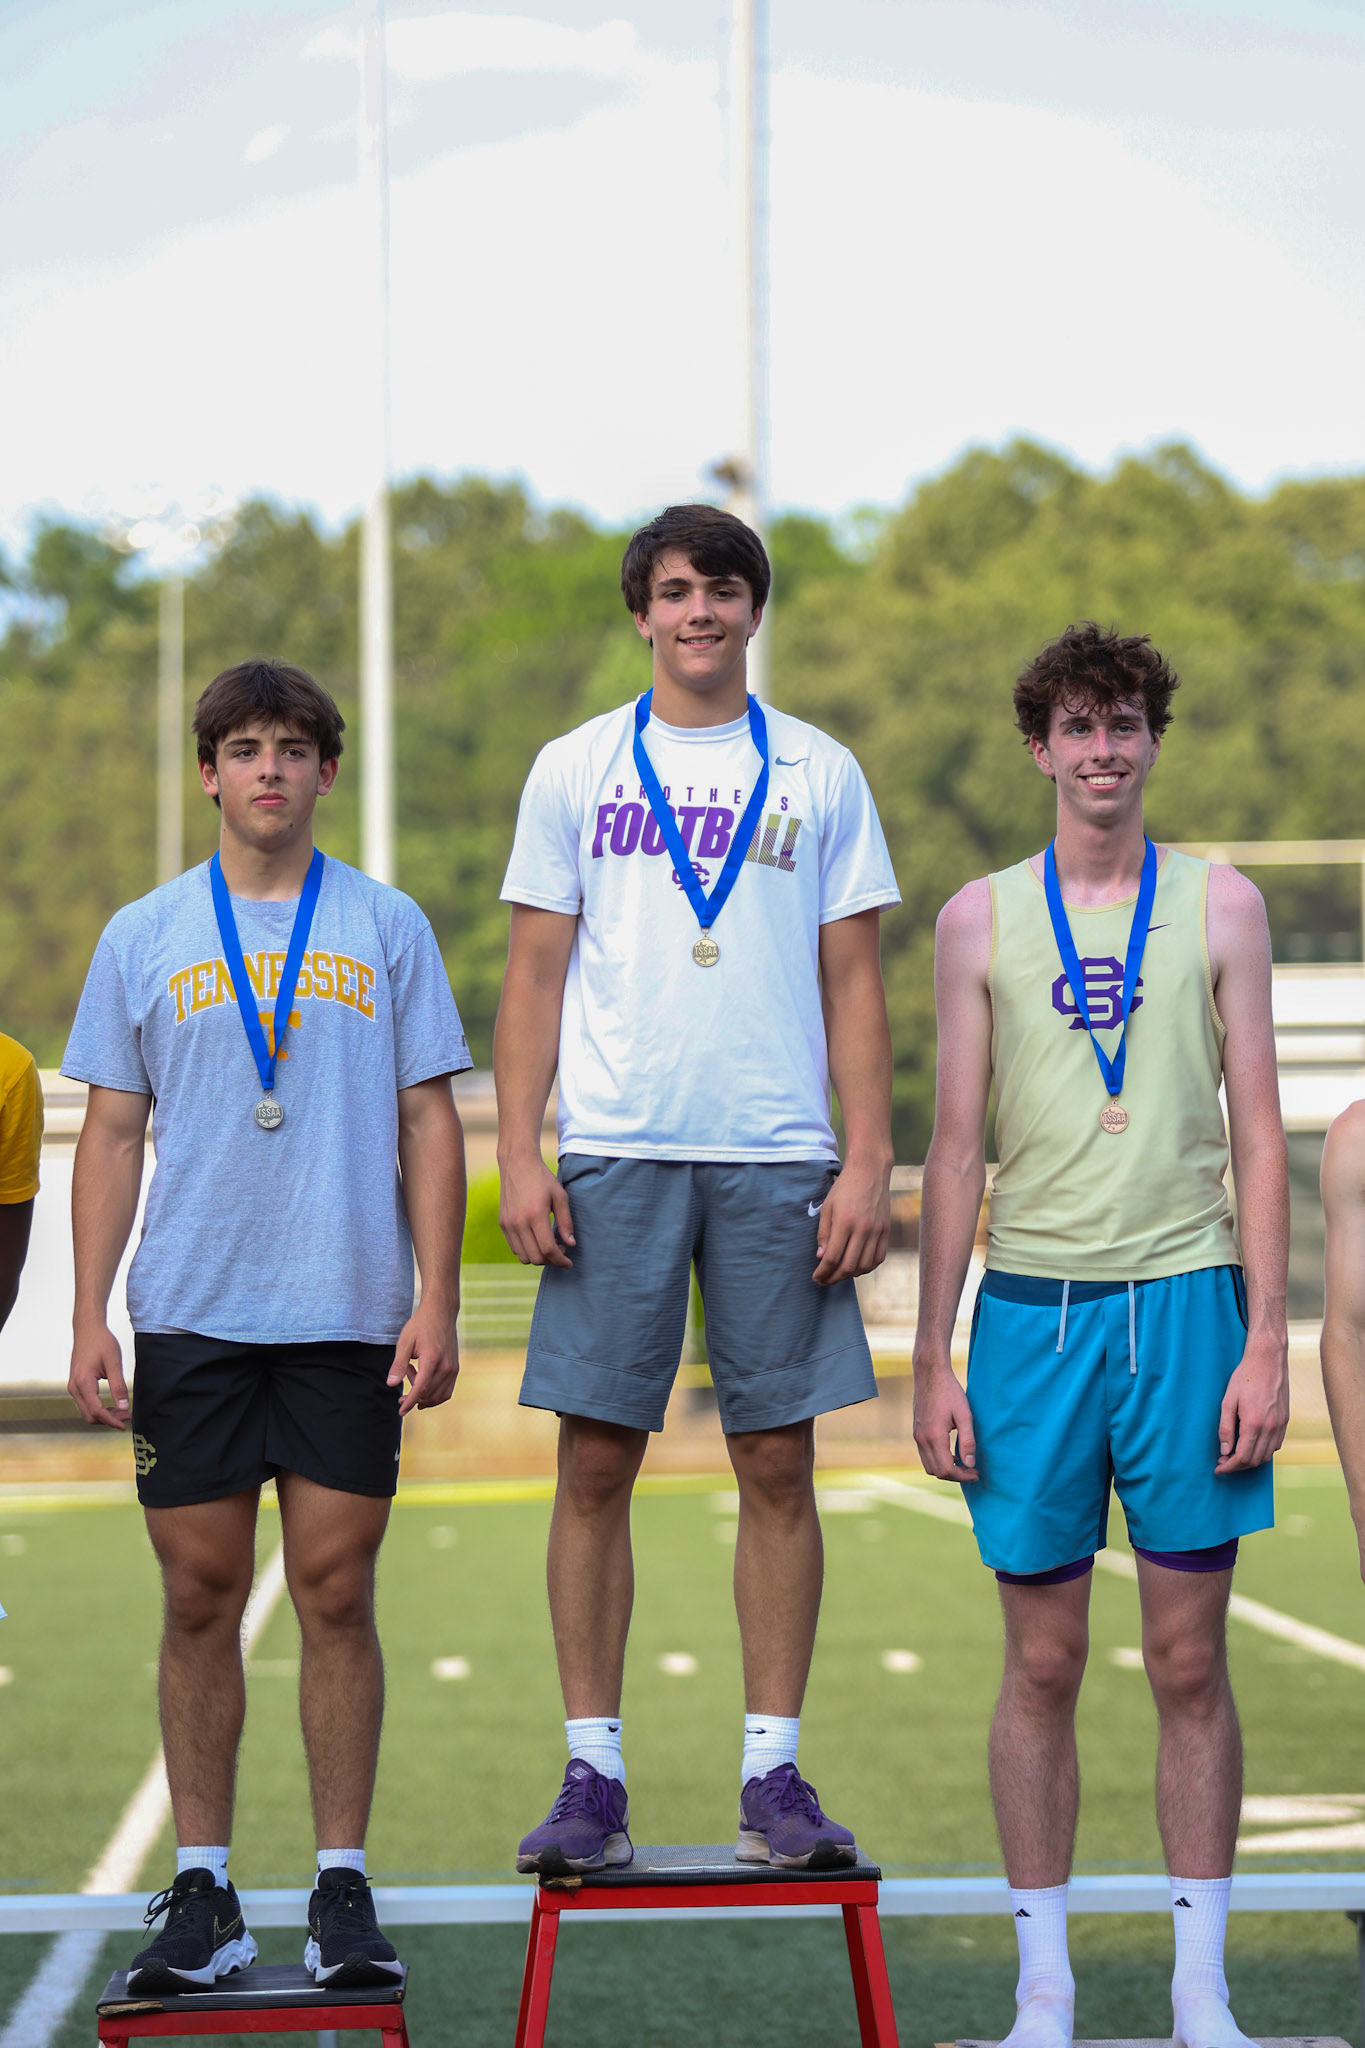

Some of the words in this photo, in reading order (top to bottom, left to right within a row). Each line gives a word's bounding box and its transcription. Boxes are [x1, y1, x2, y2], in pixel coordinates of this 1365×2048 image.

[615, 784, 788, 811] BROTHES
[695, 945, 718, 956] TSSAA
[168, 950, 376, 1026] TENNESSEE
[257, 1108, 281, 1118] TSSAA
[1103, 1113, 1127, 1123] TSSAA
